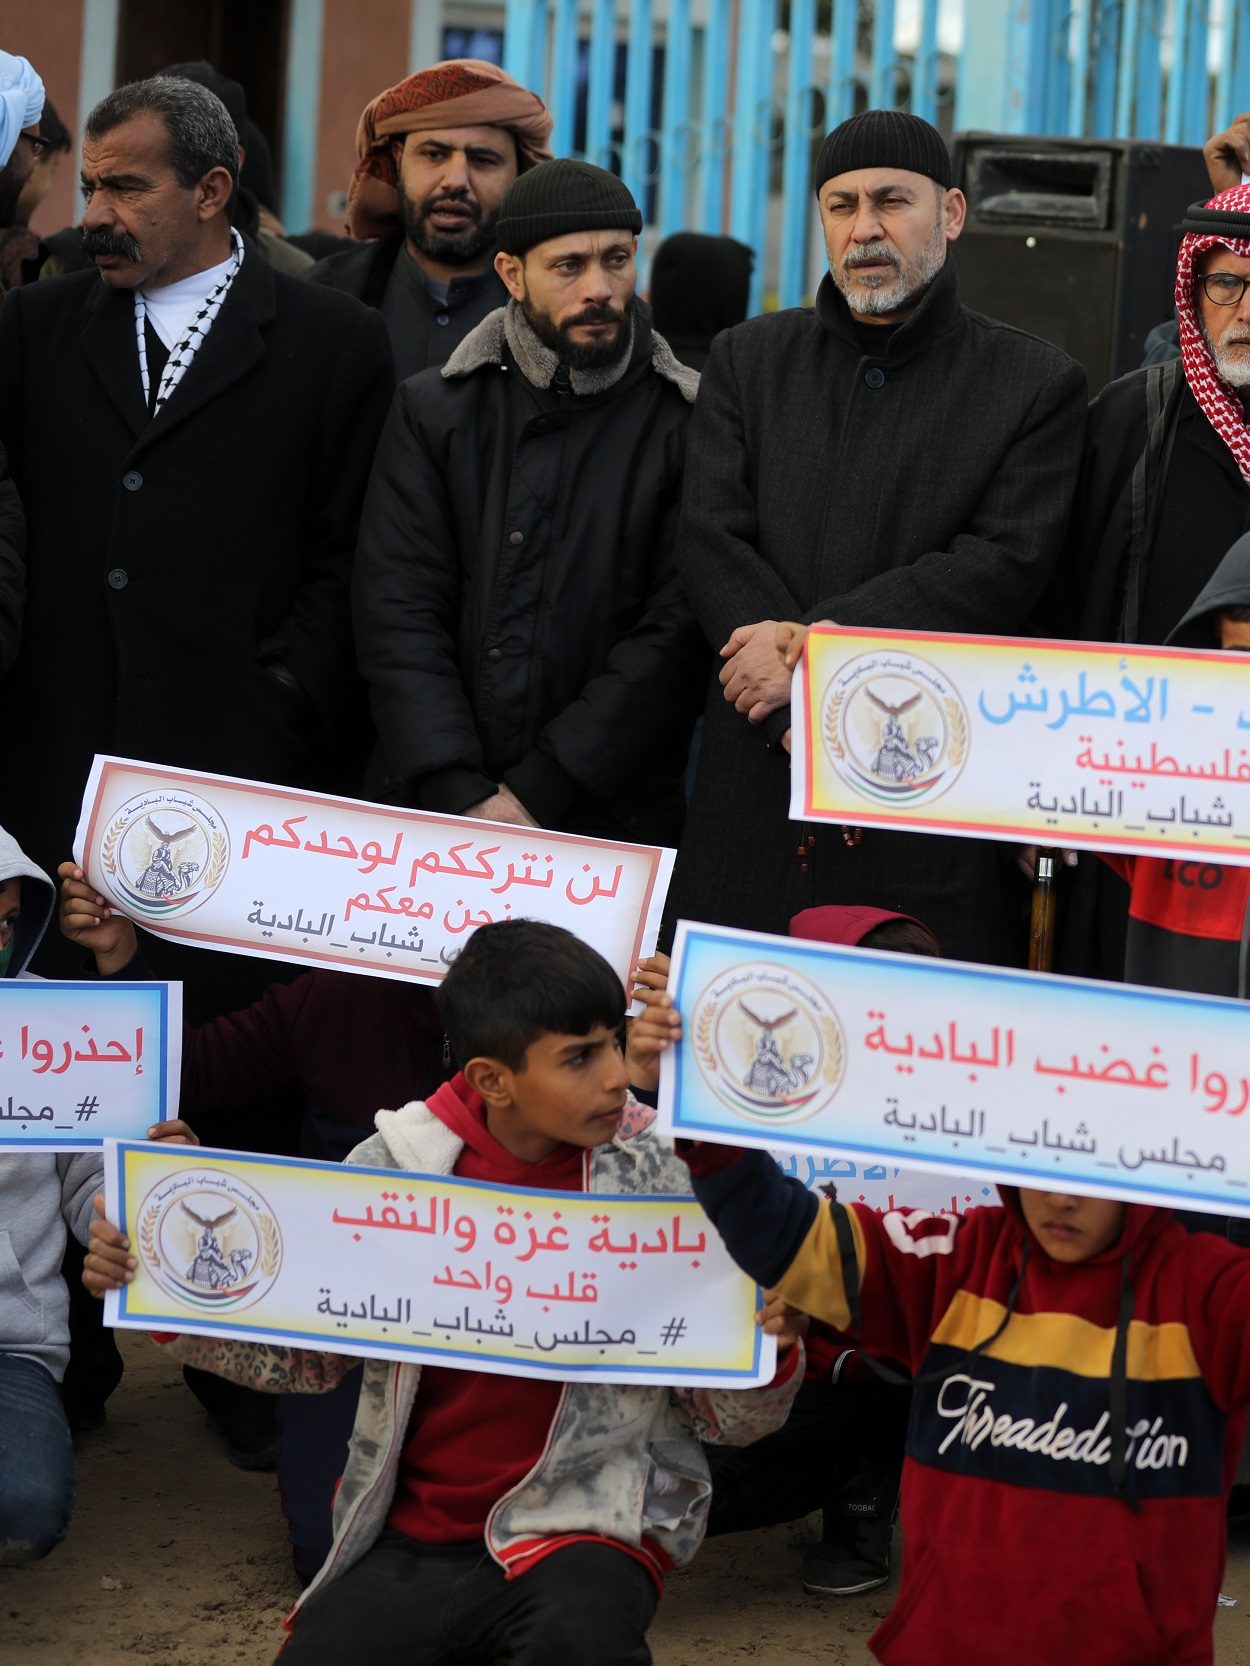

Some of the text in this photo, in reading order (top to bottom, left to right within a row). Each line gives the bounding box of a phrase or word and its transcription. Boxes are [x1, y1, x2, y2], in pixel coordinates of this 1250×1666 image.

[978, 659, 1168, 730] الأطرش
[243, 817, 622, 904] لن نترككم لوحدكم
[345, 887, 433, 921] معكم
[21, 1026, 142, 1074] إحذروا
[865, 1011, 1014, 1082] البادية
[1036, 1046, 1168, 1093] غضب
[332, 1193, 706, 1270] بادية غزة والنقب
[433, 1262, 598, 1312] قلب واحد
